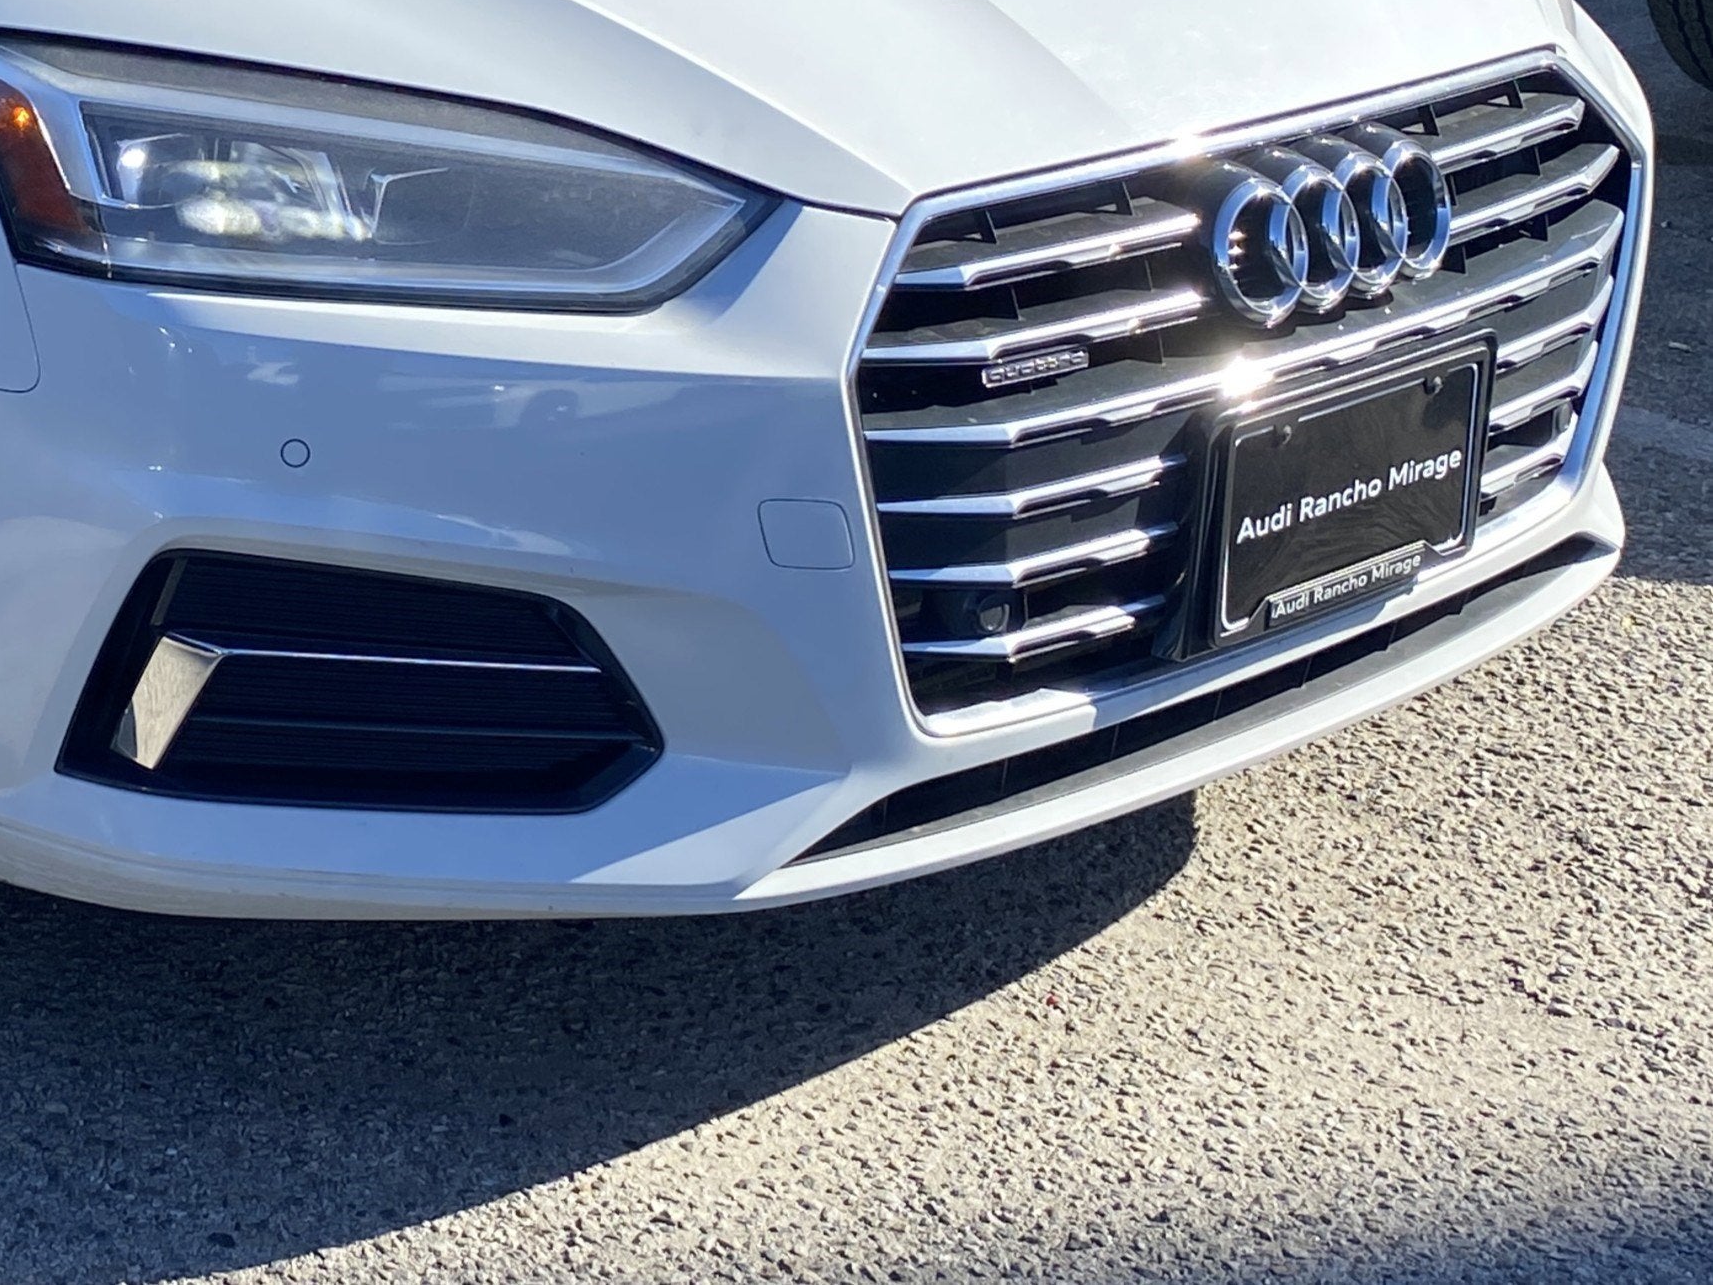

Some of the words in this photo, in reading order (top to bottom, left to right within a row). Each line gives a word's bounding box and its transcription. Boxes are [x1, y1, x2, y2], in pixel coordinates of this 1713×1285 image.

[1236, 503, 1292, 545] Audi
[1299, 479, 1383, 523] Rancho
[1388, 449, 1463, 491] Mirage
[1272, 594, 1310, 619] Audi
[1313, 573, 1368, 605] Rancho
[1371, 554, 1422, 585] Mirage
